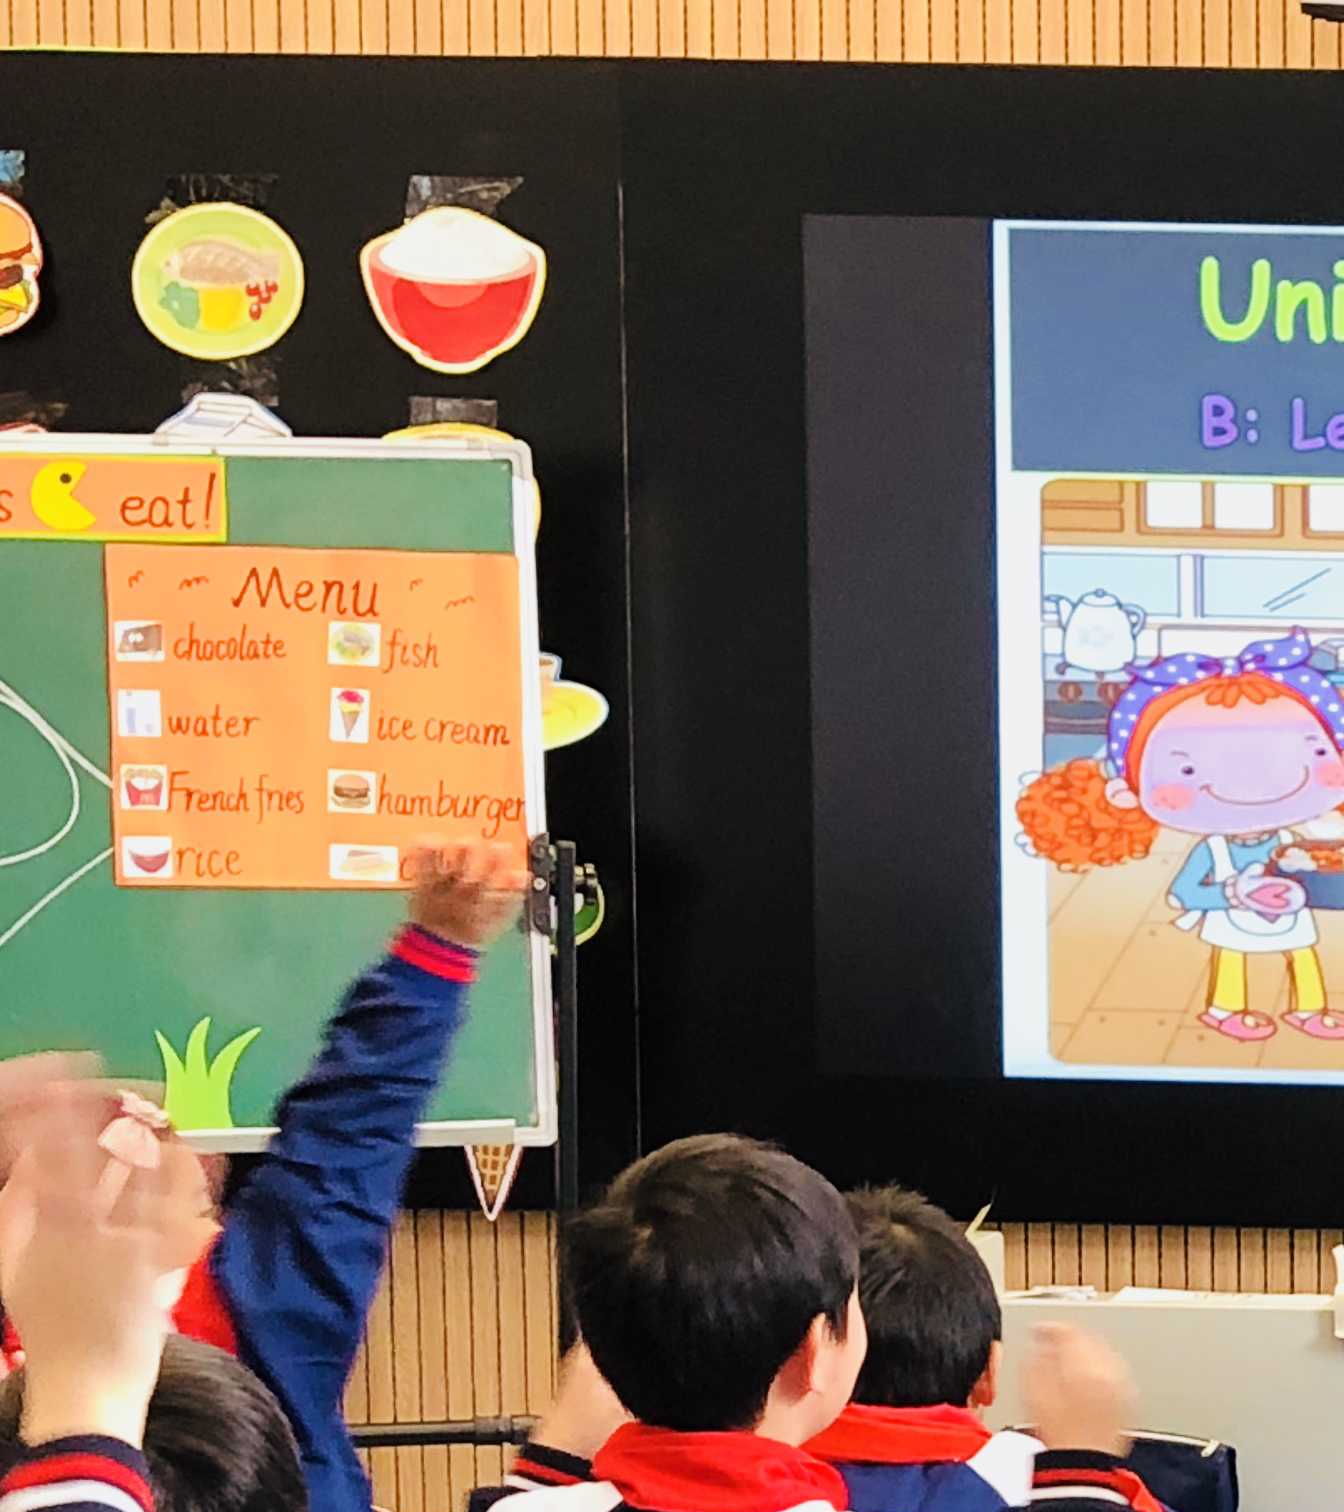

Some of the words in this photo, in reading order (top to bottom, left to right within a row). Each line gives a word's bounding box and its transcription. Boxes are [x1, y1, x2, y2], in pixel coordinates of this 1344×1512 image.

[1201, 393, 1260, 450] B:
[119, 471, 217, 530] eat!
[231, 565, 380, 618] Menu
[172, 621, 288, 662] chocolate
[381, 628, 440, 675] fish
[167, 703, 261, 739] water
[376, 709, 417, 743] ice
[423, 717, 512, 747] cream
[166, 770, 250, 814] French
[253, 773, 305, 826] fries
[376, 772, 526, 840] hamburger
[175, 846, 244, 878] rice
